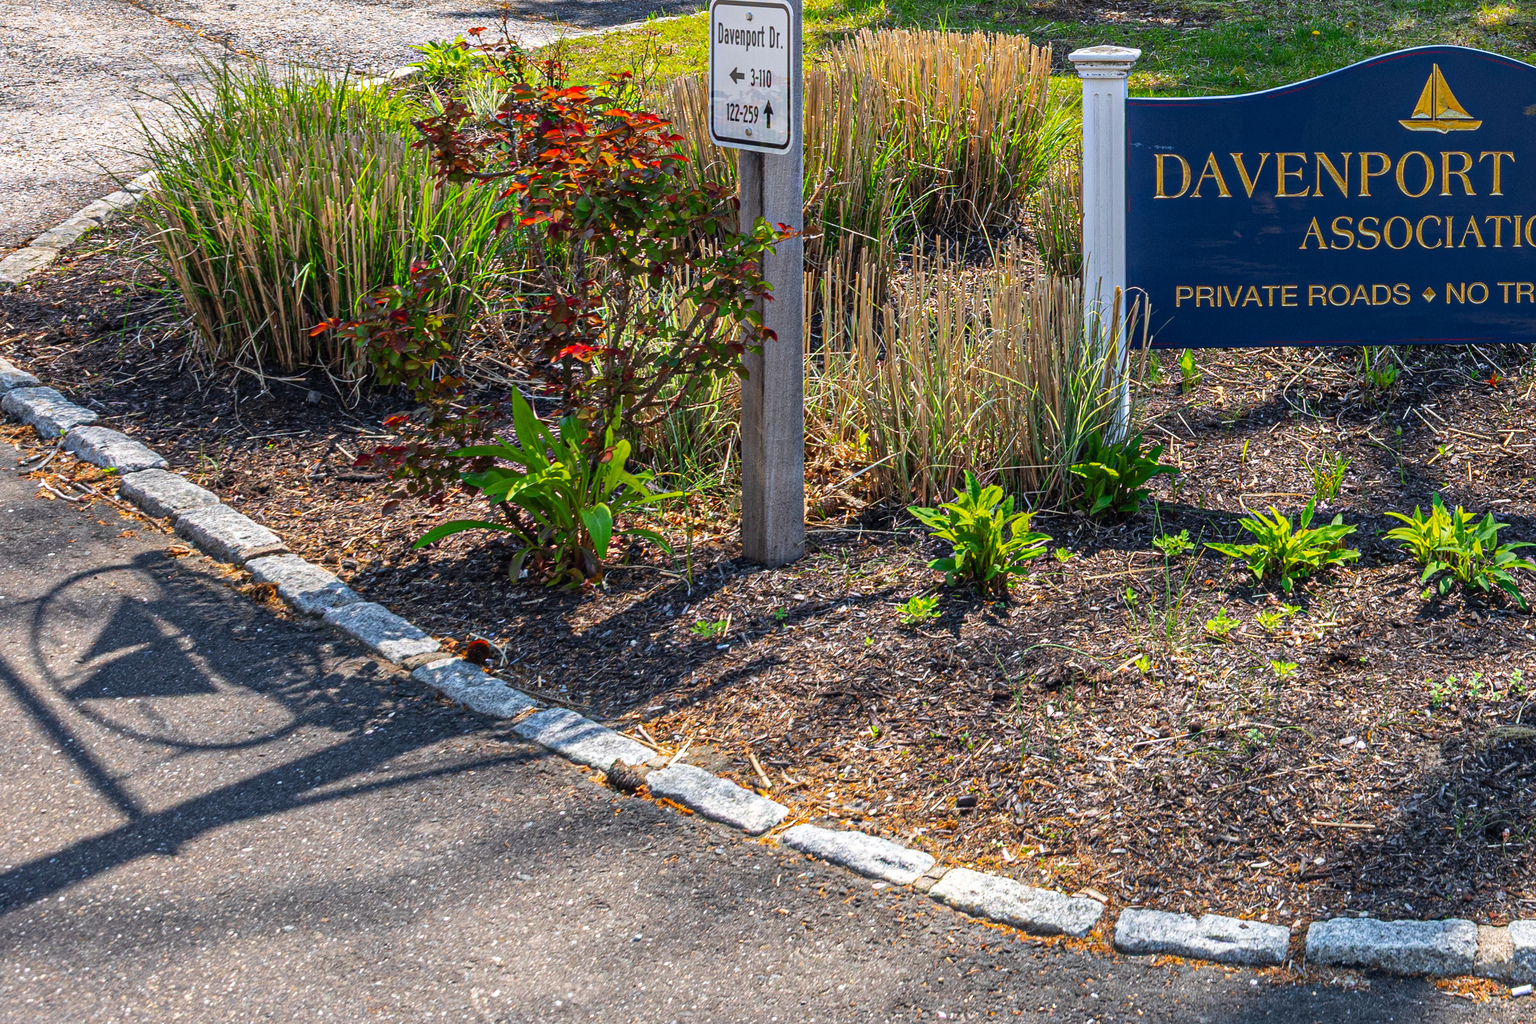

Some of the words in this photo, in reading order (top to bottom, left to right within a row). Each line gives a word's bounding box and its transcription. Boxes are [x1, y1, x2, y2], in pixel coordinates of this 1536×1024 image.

[717, 22, 766, 52] Davenport
[769, 26, 784, 50] Dr.
[750, 68, 772, 88] 3-110
[726, 102, 759, 125] 122-259
[1153, 150, 1516, 200] DAVENPORT
[1175, 284, 1298, 308] PRIVATE
[1307, 282, 1411, 307] ROADS
[1445, 281, 1490, 305] NO
